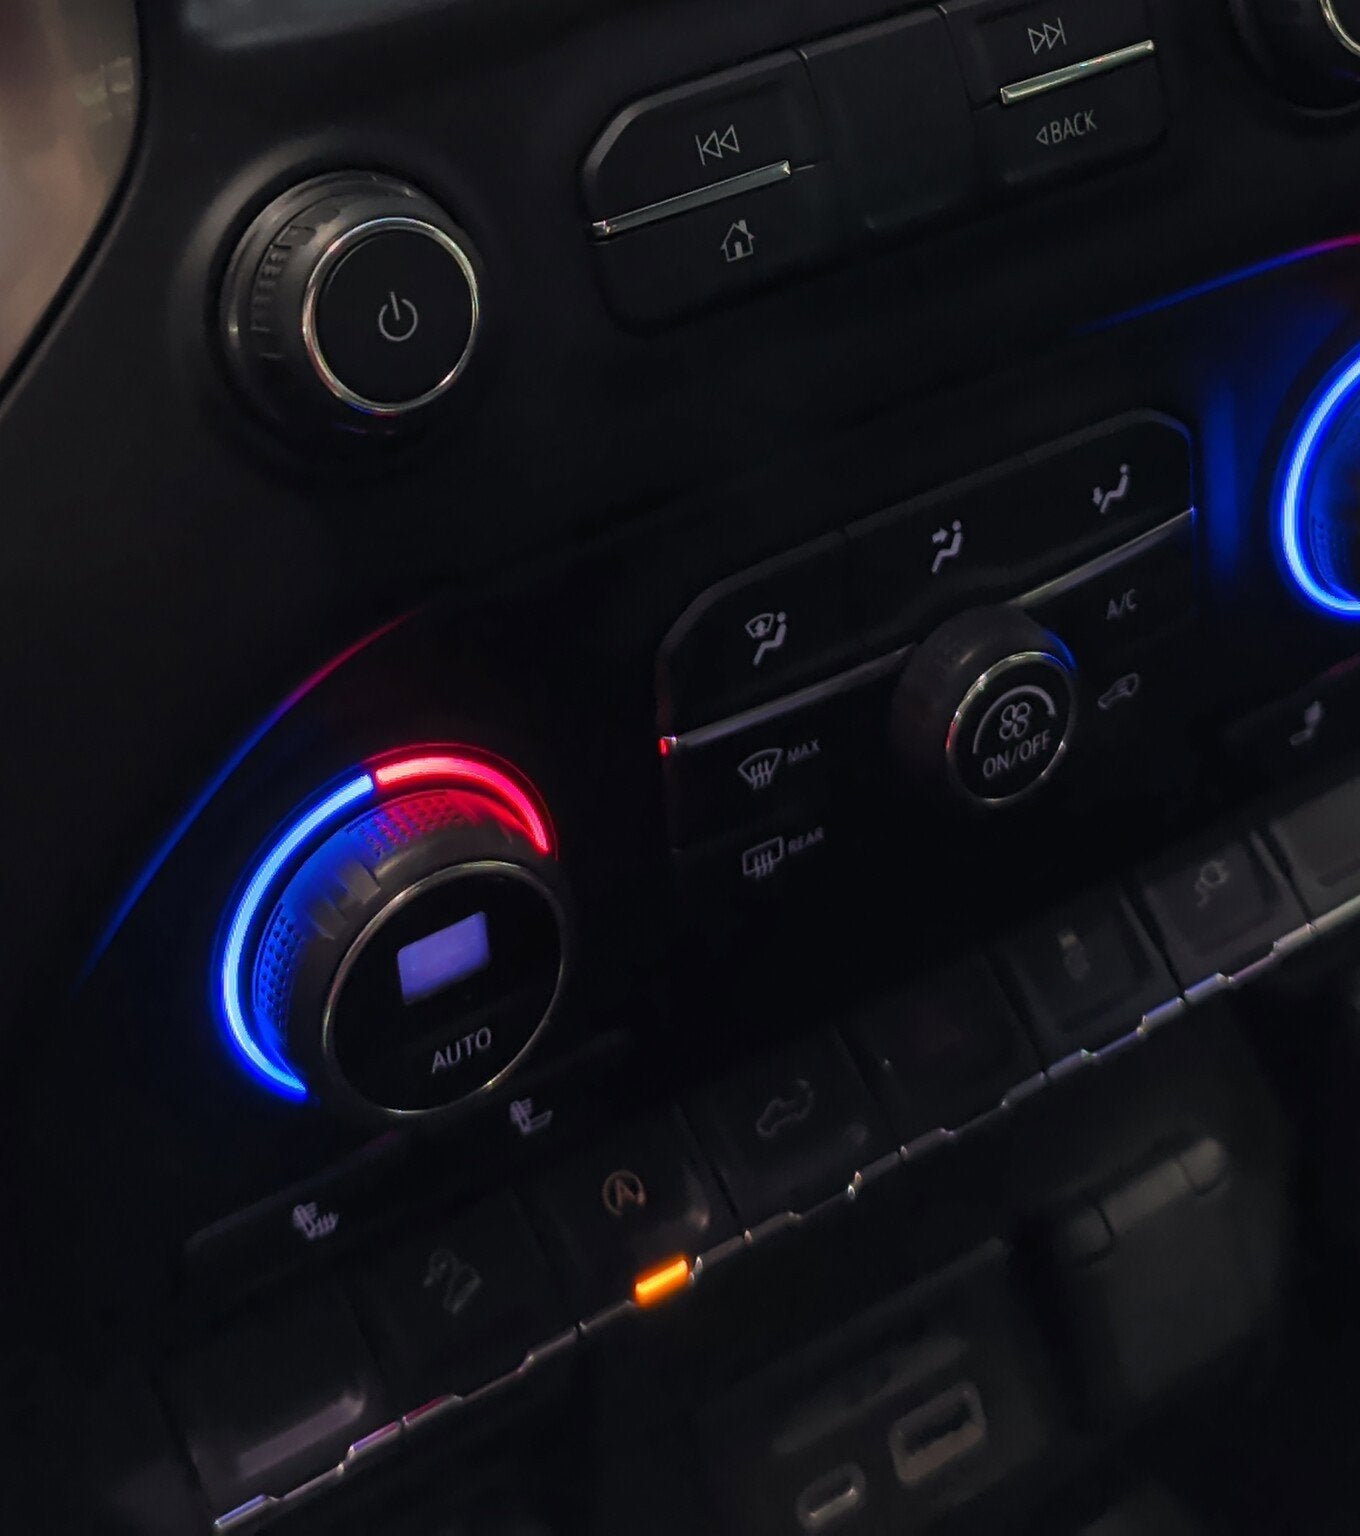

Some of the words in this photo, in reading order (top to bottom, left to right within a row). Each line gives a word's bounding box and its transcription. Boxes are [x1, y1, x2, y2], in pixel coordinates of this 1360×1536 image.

[1049, 108, 1098, 145] BACK
[1105, 587, 1139, 622] A/C
[787, 737, 822, 765] MAX
[982, 728, 1051, 779] ON/OFF
[788, 825, 825, 856] REAR
[430, 1025, 492, 1075] AUTO
